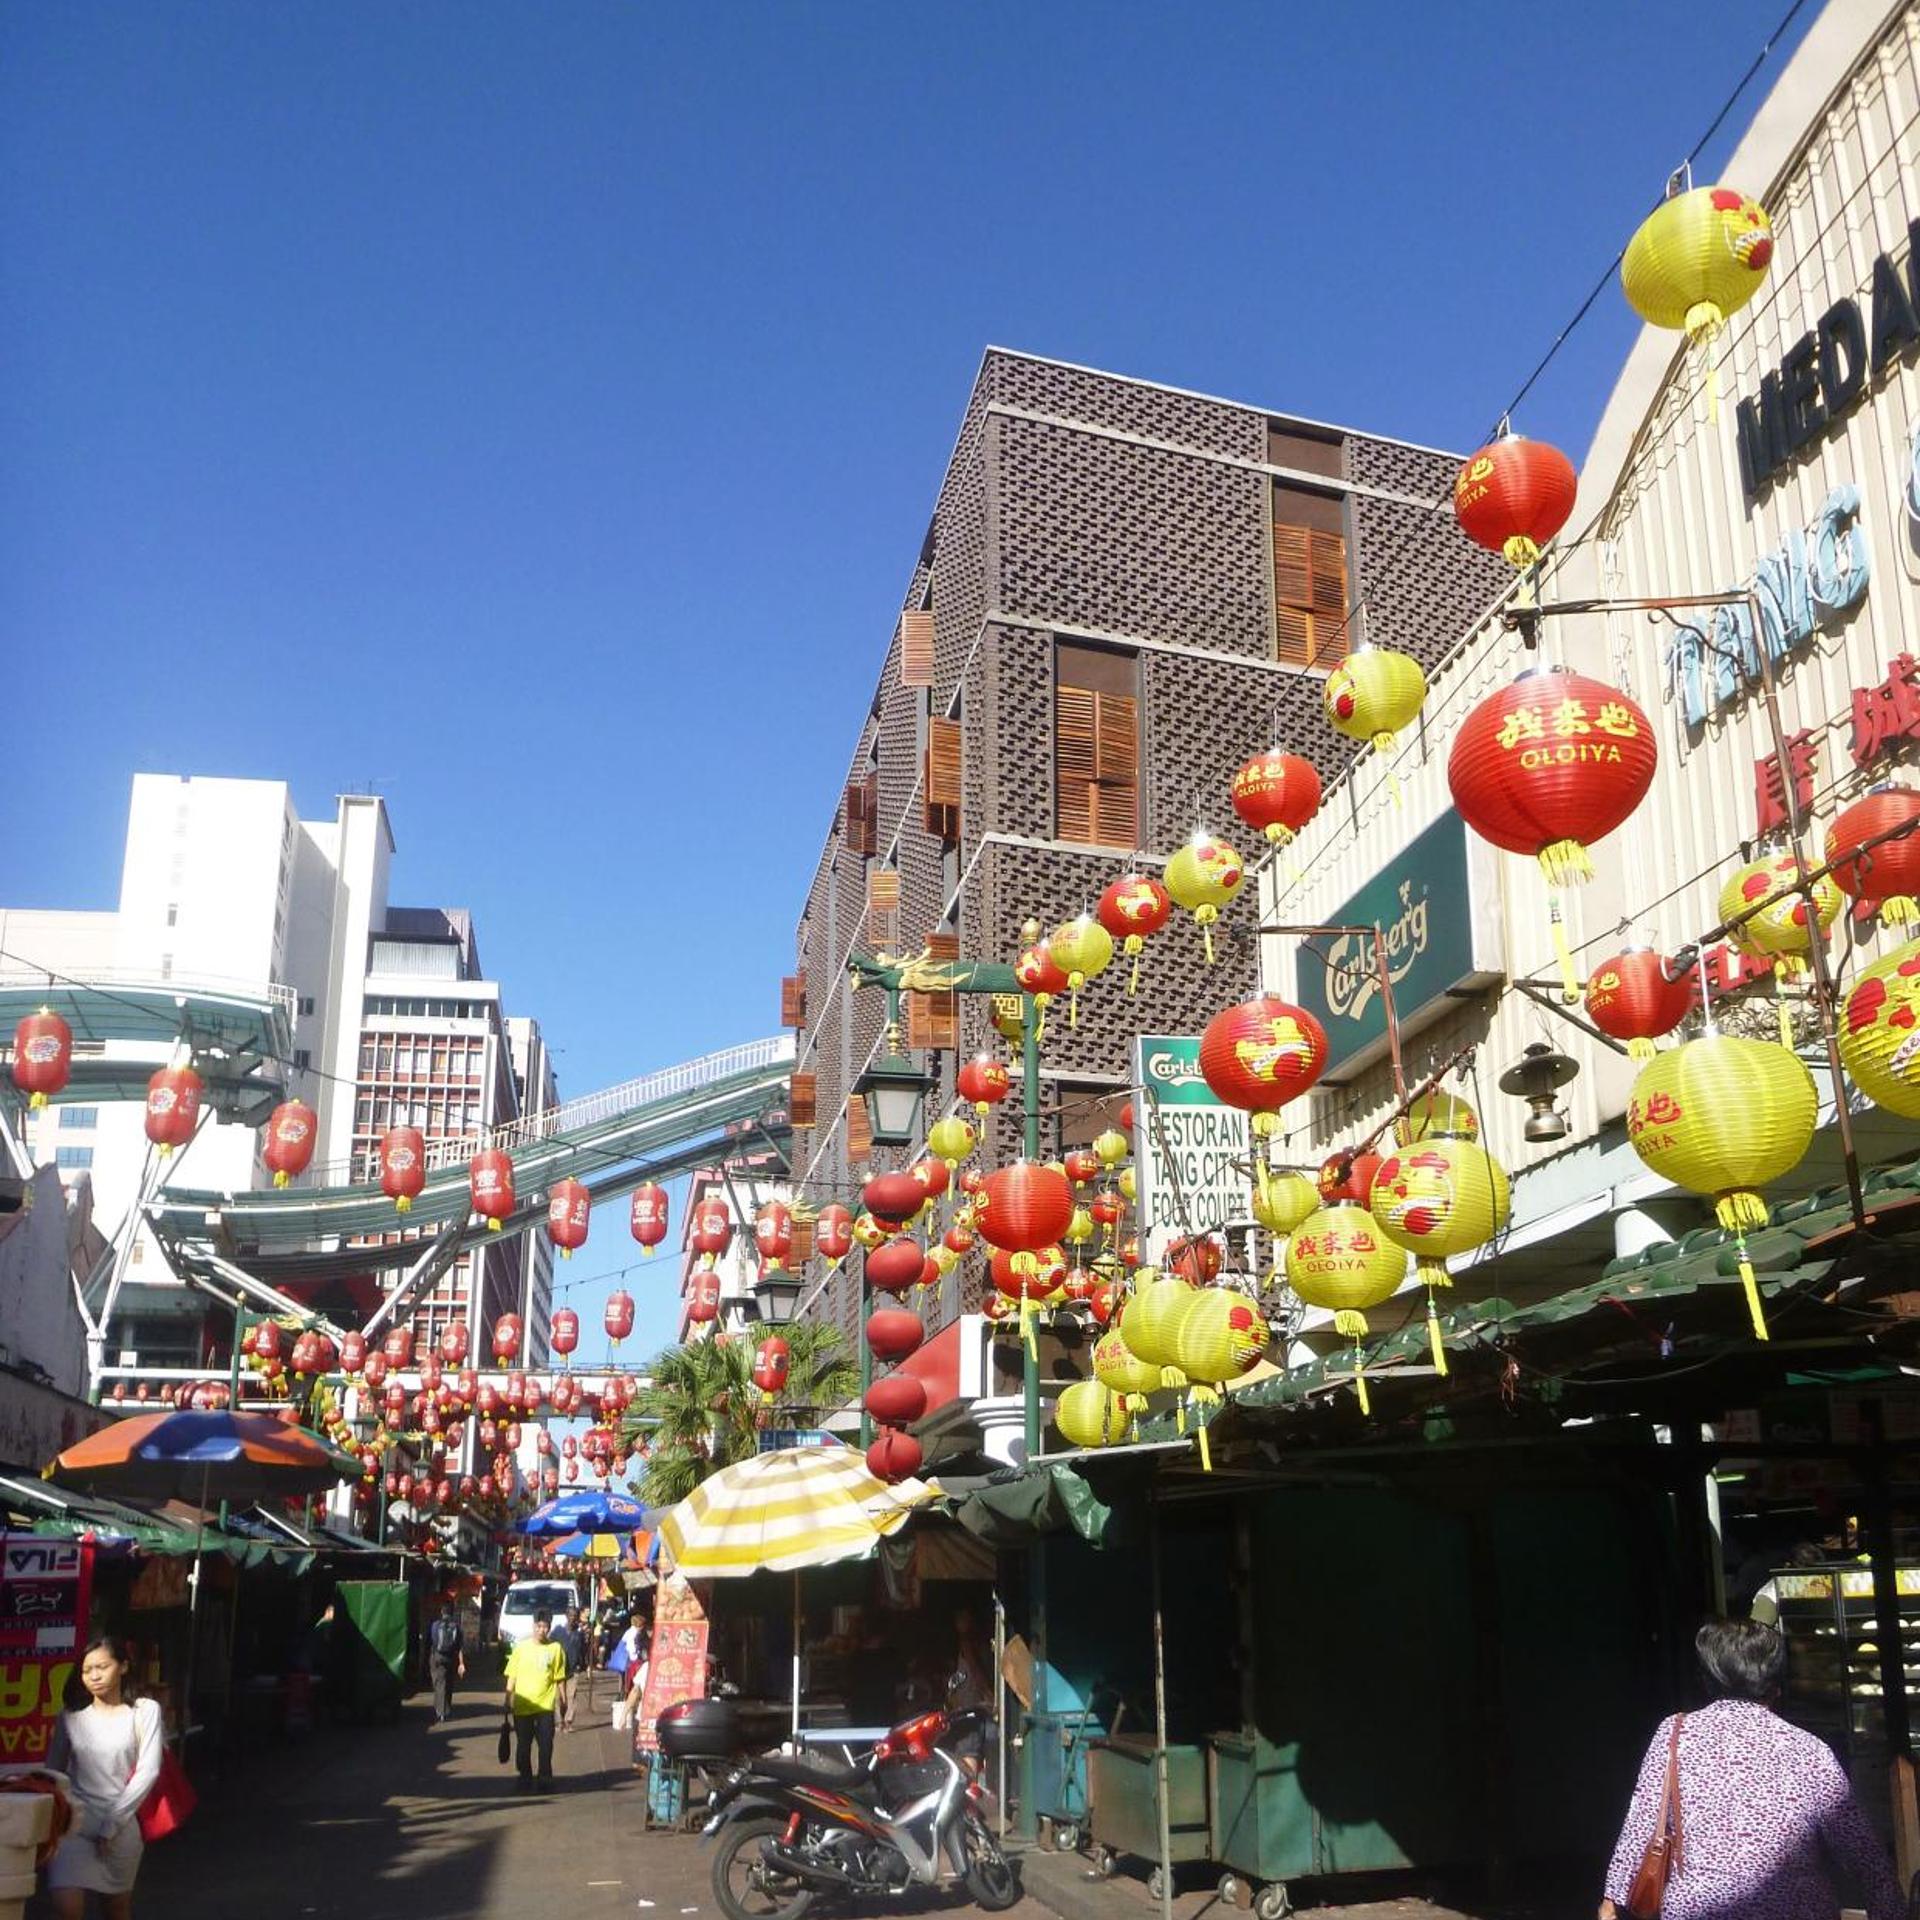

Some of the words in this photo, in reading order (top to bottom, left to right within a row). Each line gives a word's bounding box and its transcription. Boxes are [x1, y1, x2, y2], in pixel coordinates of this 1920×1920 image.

[1663, 482, 1870, 727] TANG
[1520, 743, 1622, 770] OLOIYA
[1149, 1052, 1203, 1081] Carlsb
[1148, 1111, 1244, 1148] RESTORAN
[1152, 1151, 1198, 1188] TANG
[1203, 1150, 1242, 1188] CITY
[1307, 1259, 1366, 1274] OLOIYA
[9, 1549, 79, 1573] FILA
